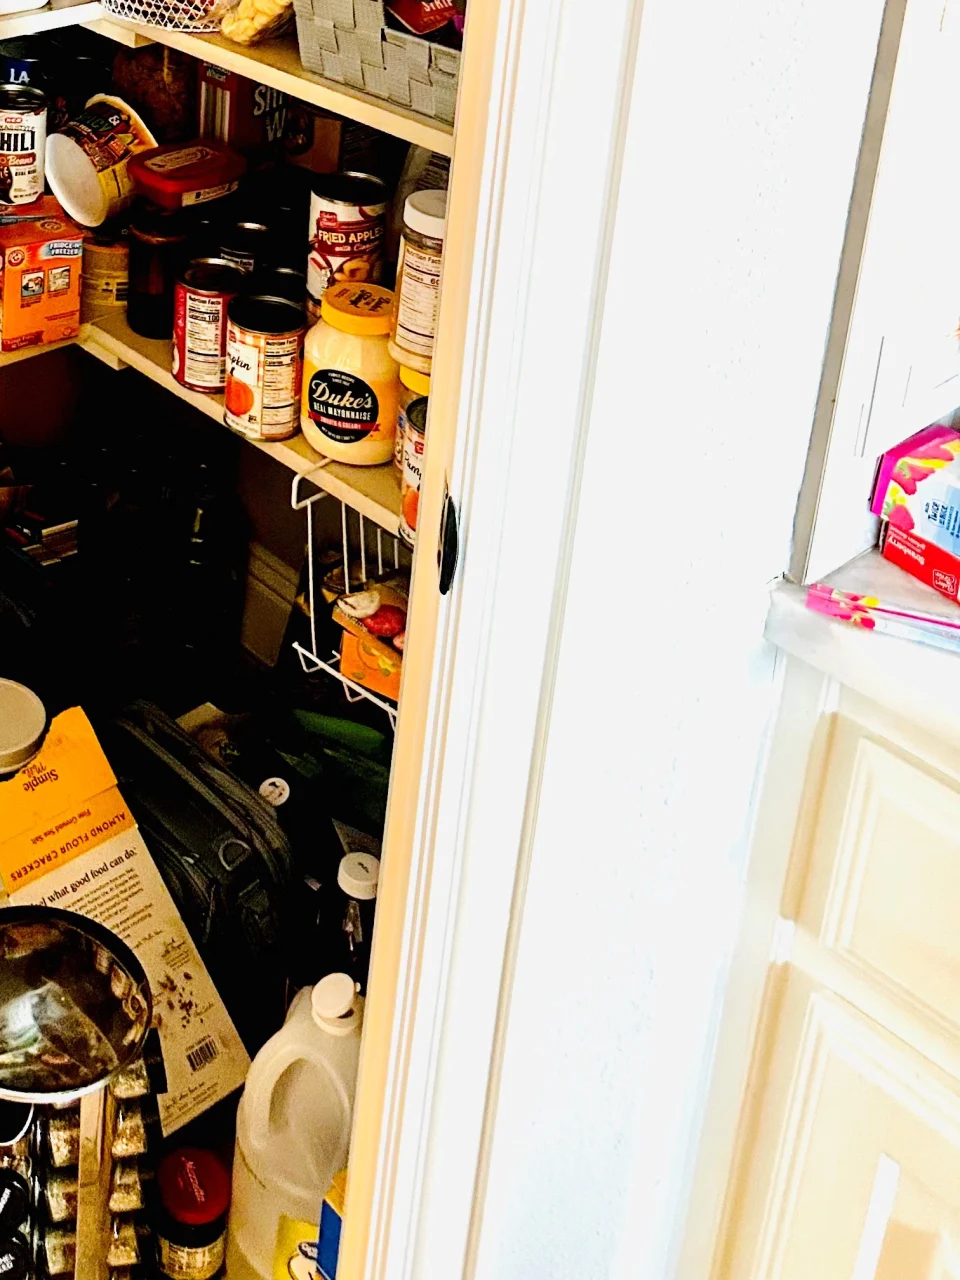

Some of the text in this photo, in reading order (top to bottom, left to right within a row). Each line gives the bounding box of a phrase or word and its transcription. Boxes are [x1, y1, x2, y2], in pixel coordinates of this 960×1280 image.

[6, 153, 34, 167] Beans
[318, 227, 384, 245] FRIED APPLES
[427, 256, 441, 265] Fact
[207, 313, 220, 323] 100
[226, 351, 252, 372] mpkin
[310, 379, 373, 410] Duke's
[313, 401, 372, 421] REAL MAYONNAISE
[887, 534, 926, 566] Strawberry
[23, 768, 59, 793] Simple
[30, 808, 91, 846] Fine Ground Sea Salt
[10, 811, 126, 882] ALMOND FLOUR CRACKERS
[47, 886, 69, 903] what
[70, 873, 91, 892] good
[90, 863, 109, 878] food
[109, 855, 125, 869] can
